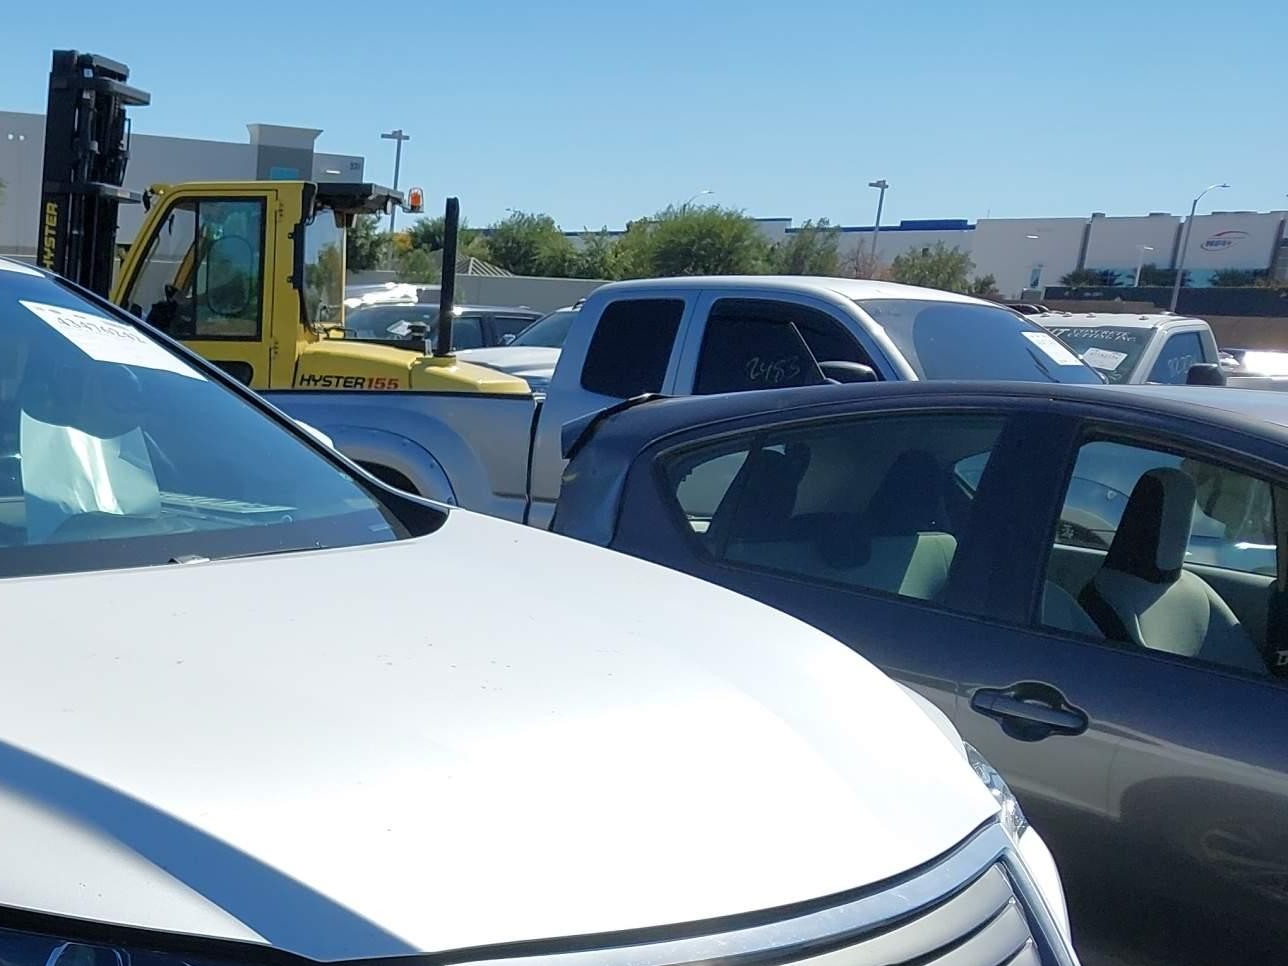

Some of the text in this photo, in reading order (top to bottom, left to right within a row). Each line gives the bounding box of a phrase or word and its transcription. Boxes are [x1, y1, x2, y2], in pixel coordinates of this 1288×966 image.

[43, 202, 58, 271] HYSTER
[299, 374, 400, 389] HYSTER 155
